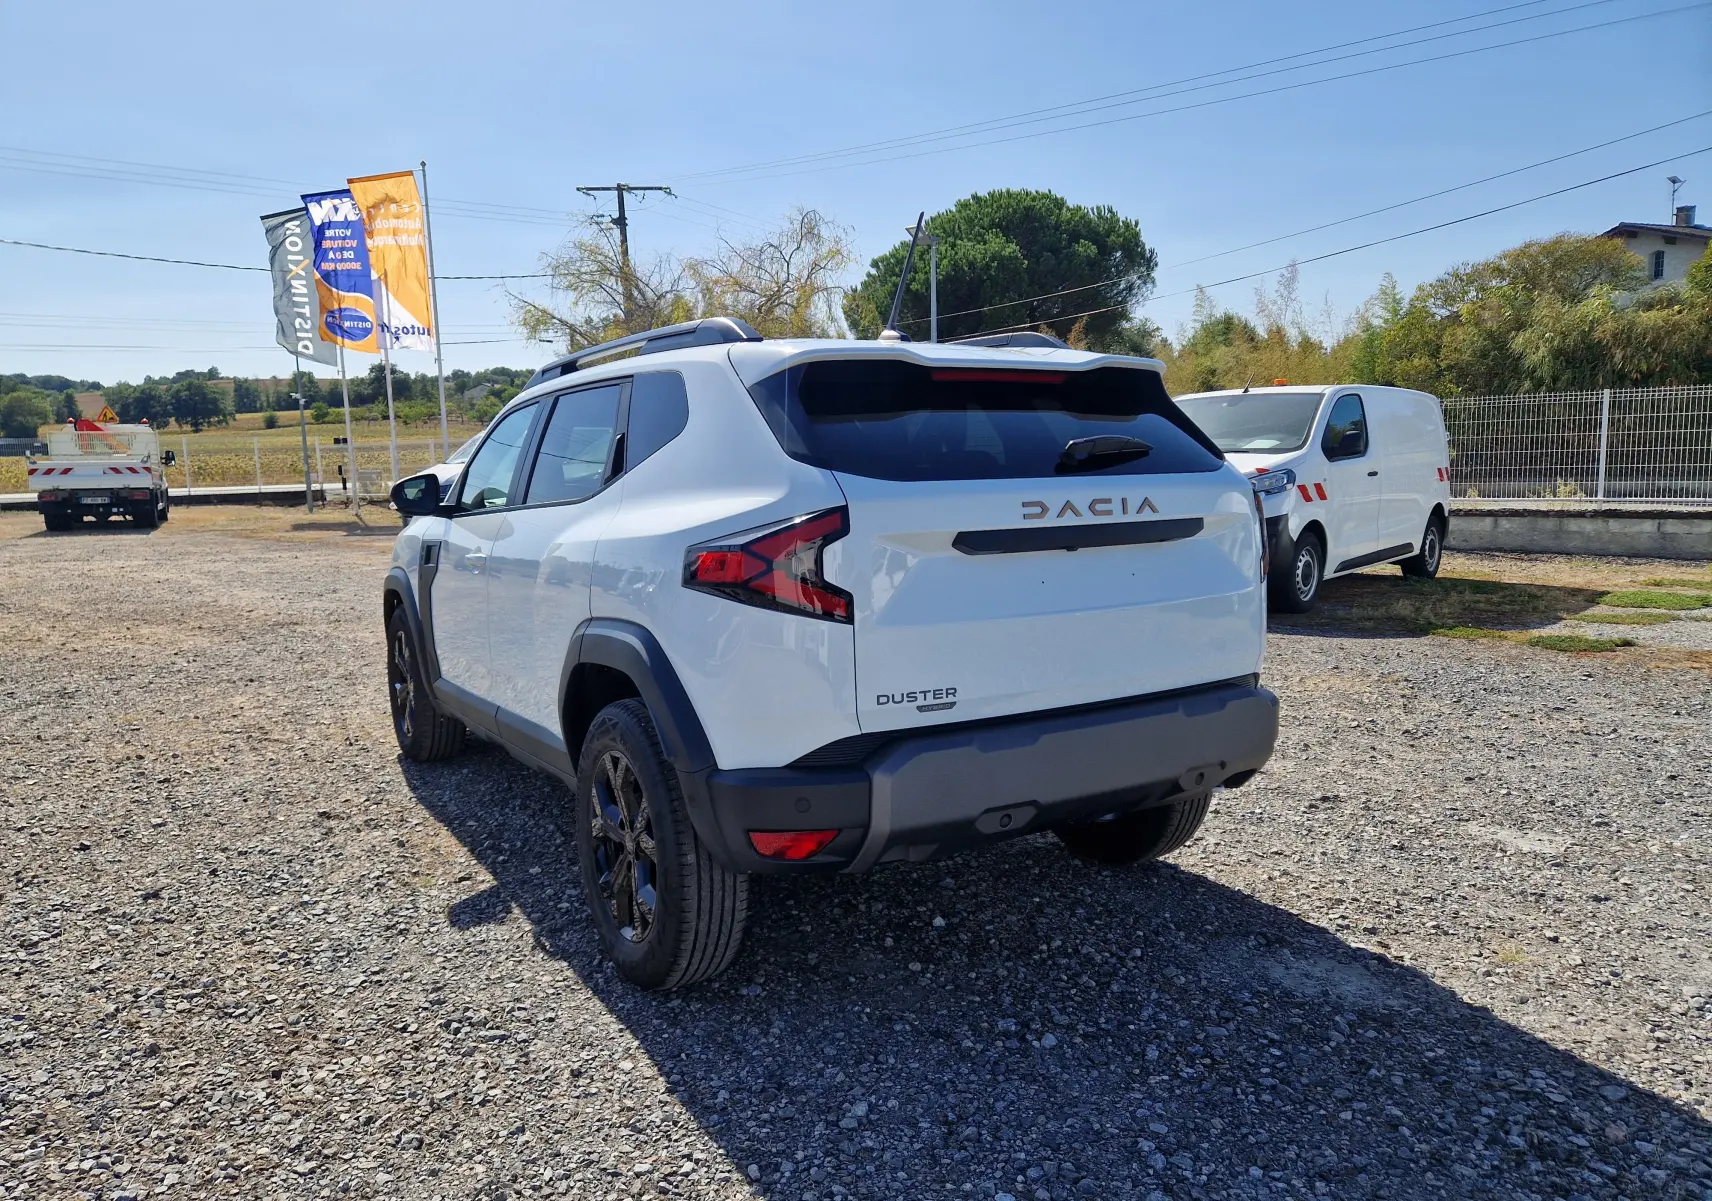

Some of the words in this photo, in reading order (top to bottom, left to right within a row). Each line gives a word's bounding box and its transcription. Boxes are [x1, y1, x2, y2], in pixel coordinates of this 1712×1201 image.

[1022, 496, 1160, 521] DACIA
[876, 687, 958, 706] DUSTER
[922, 703, 951, 712] HYBRID
